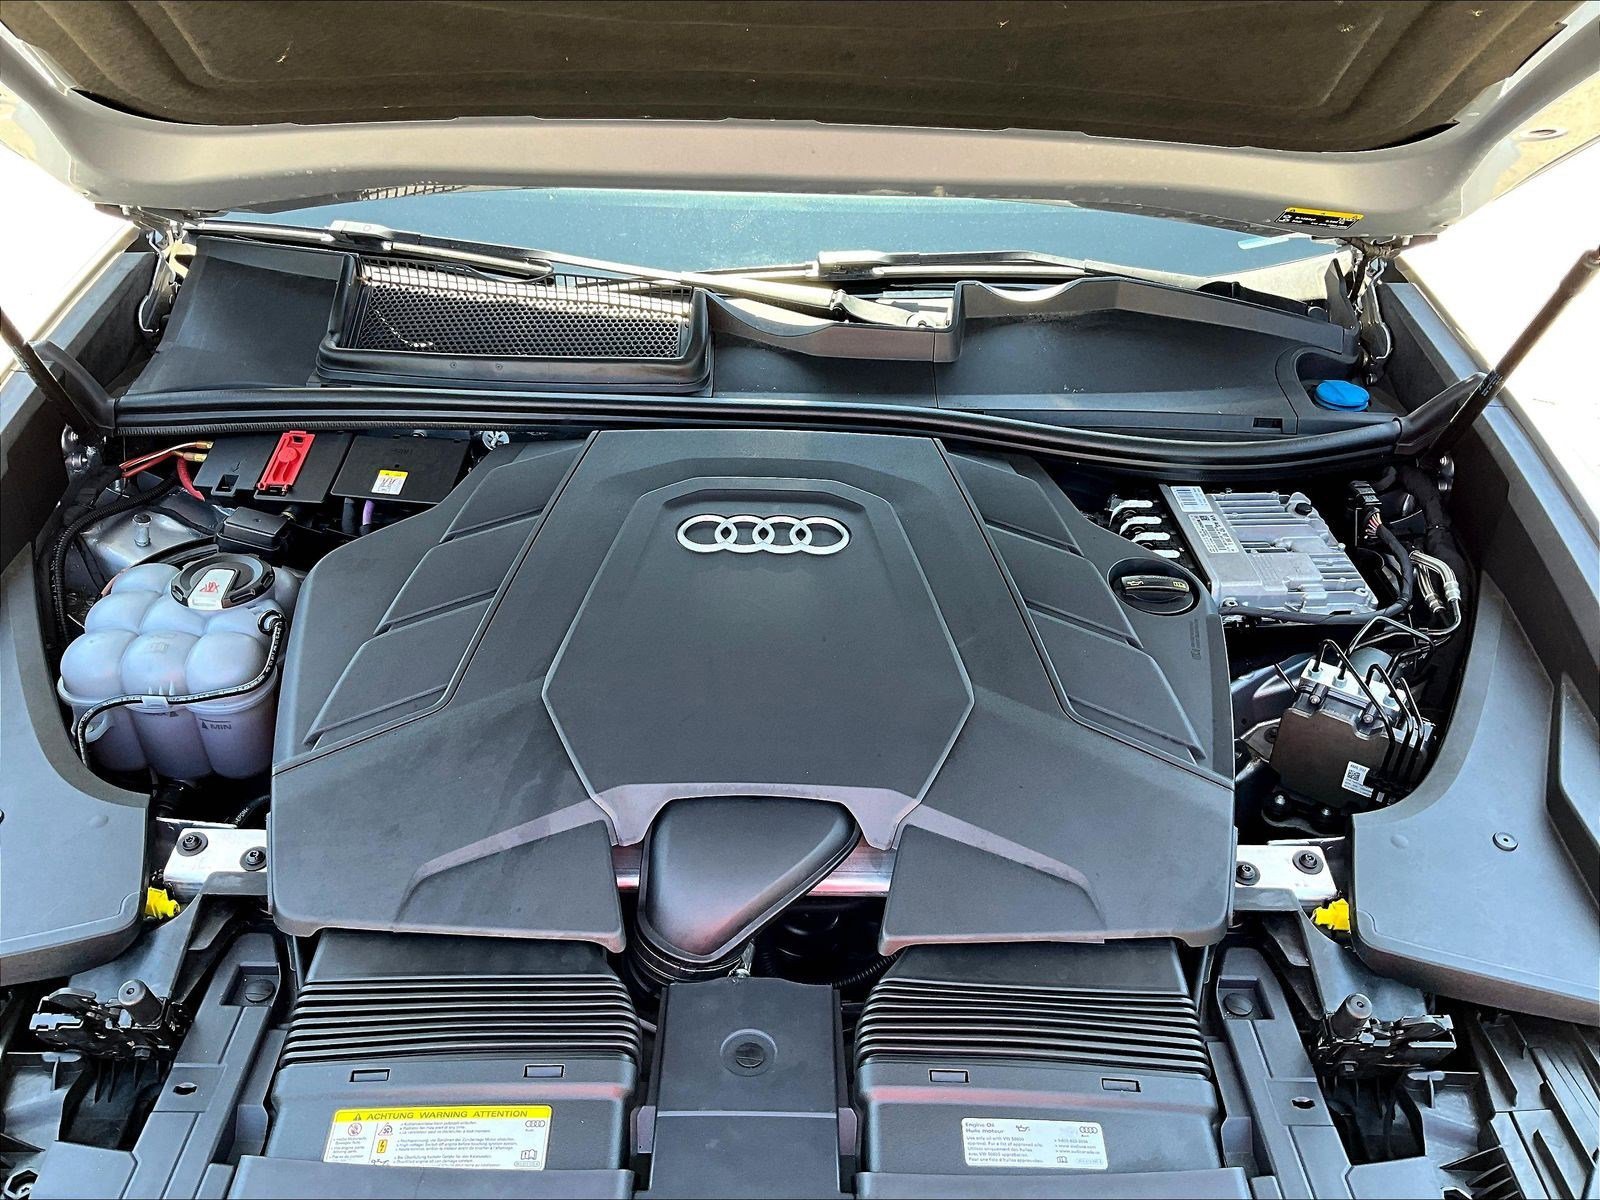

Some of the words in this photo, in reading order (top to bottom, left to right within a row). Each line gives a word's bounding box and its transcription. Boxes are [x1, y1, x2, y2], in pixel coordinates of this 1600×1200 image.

[367, 1112, 414, 1120] ACHTUNG
[420, 1110, 468, 1118] WARNING
[473, 1110, 528, 1118] ATTENTION
